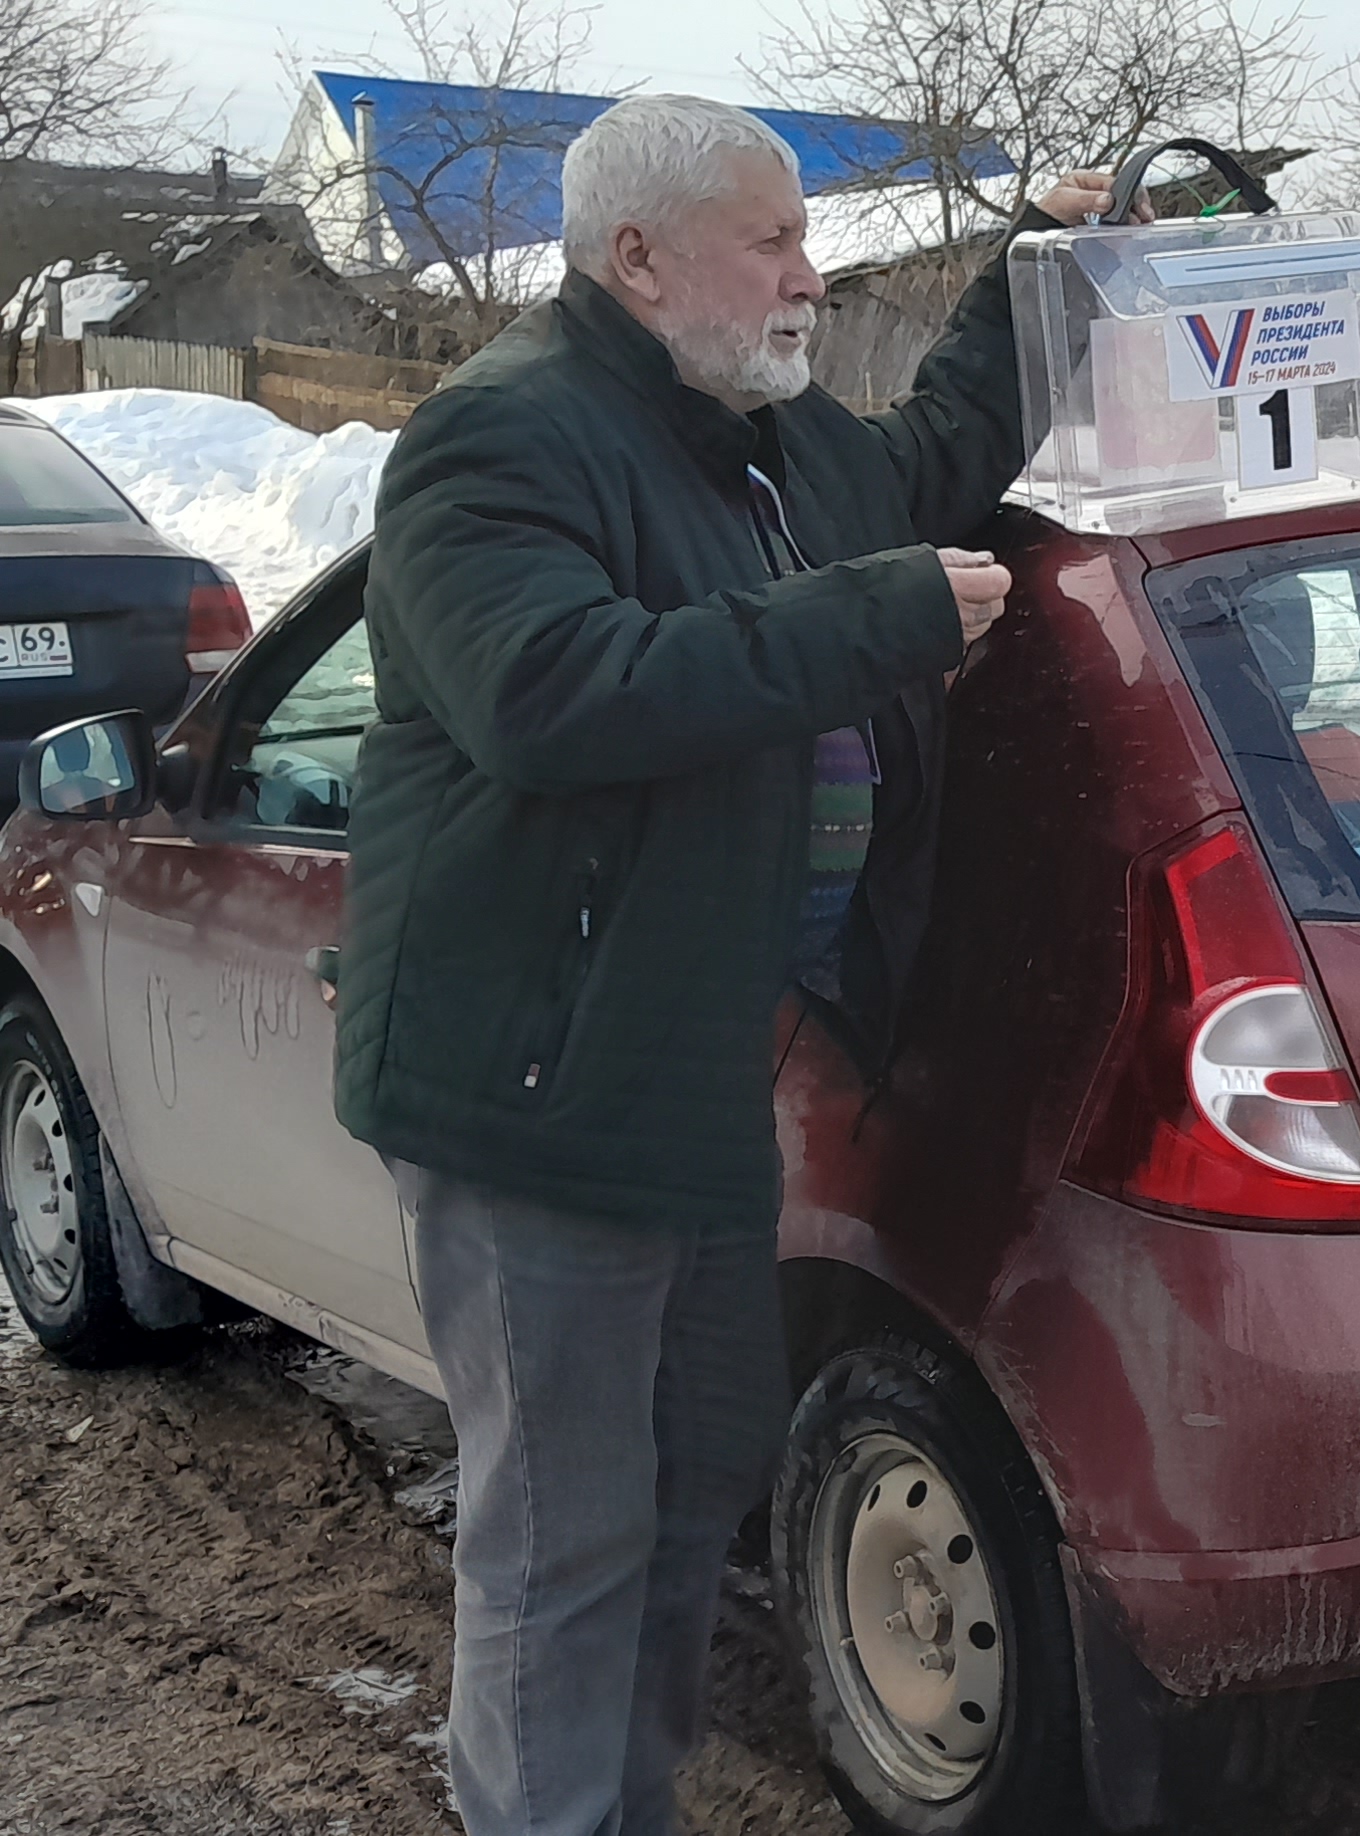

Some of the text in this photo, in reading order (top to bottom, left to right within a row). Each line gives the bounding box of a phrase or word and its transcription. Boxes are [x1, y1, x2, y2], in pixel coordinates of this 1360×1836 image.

[1262, 301, 1325, 322] ВЫБОРЫ
[1256, 319, 1345, 345] ПРЕЗИДЕНТА
[1250, 344, 1309, 366] РОССИИ
[1277, 364, 1311, 381] МАРТА
[1312, 361, 1336, 377] 2024
[1259, 388, 1292, 471] 1
[21, 626, 55, 652] 69
[21, 652, 48, 662] RUS
